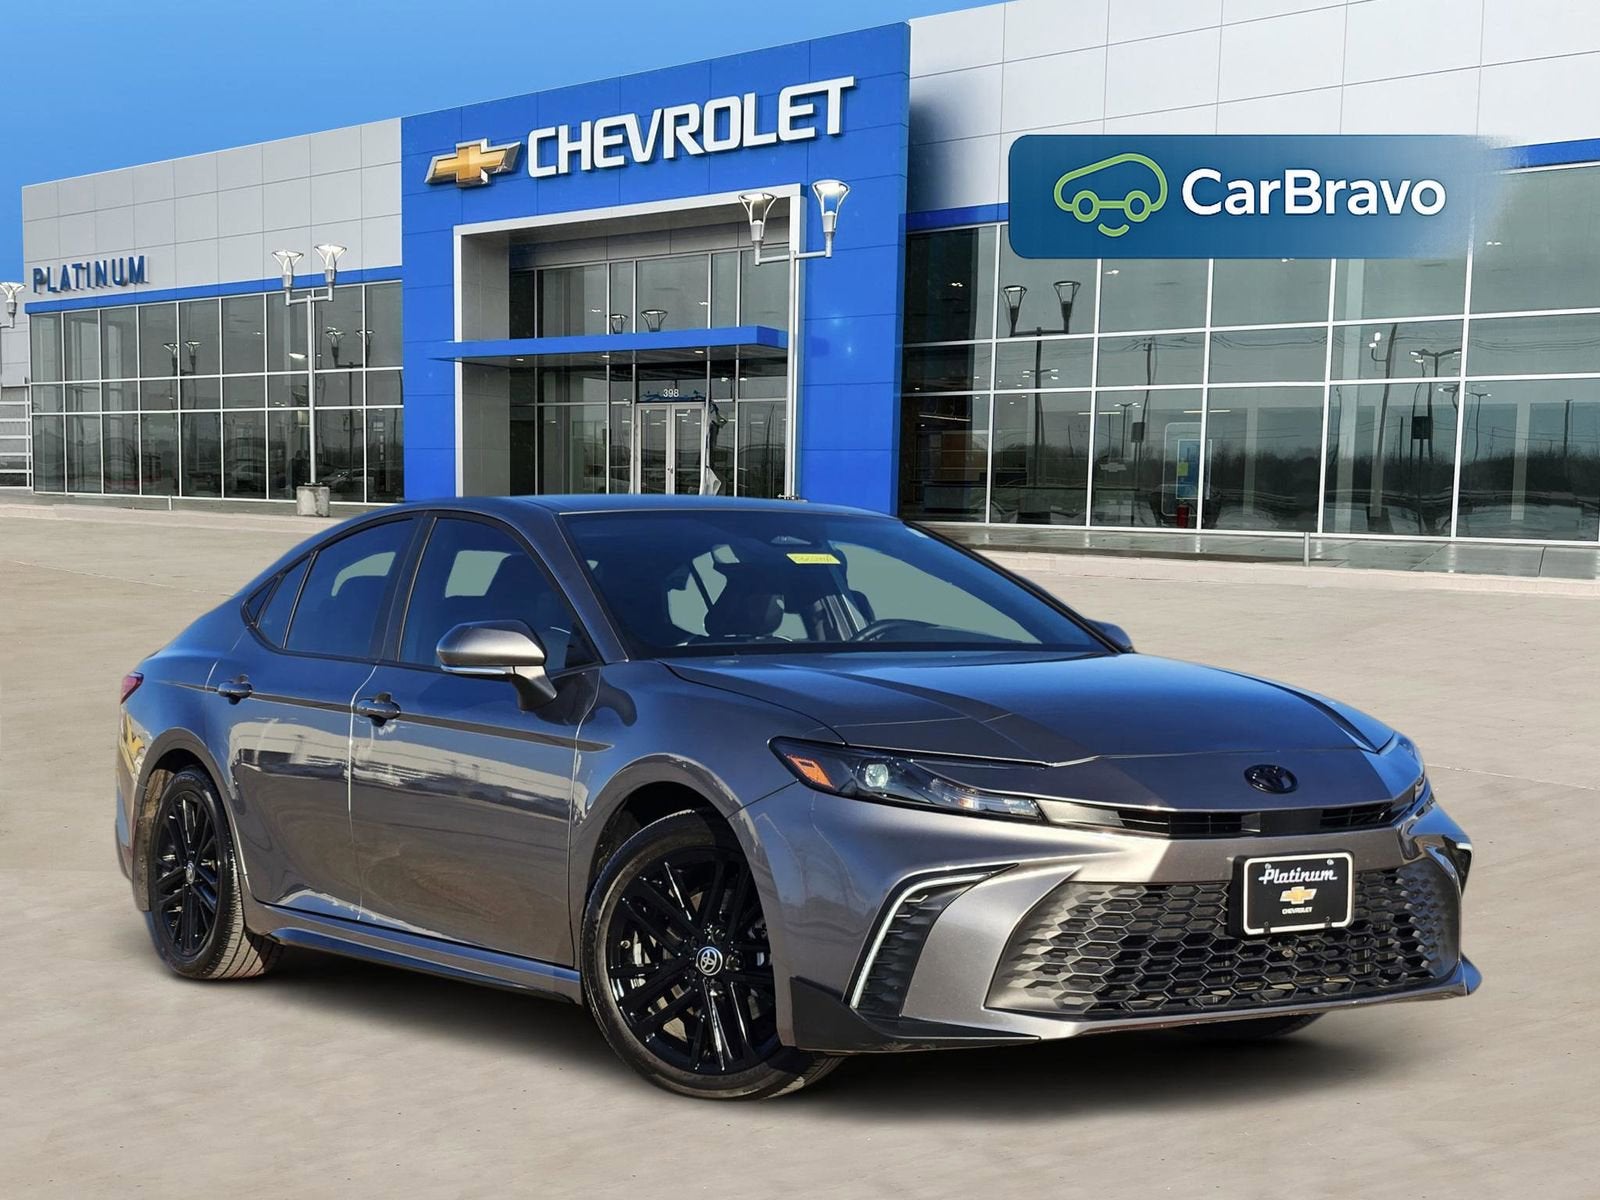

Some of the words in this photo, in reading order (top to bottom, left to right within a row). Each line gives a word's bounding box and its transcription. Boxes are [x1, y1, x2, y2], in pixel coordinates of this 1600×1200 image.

[528, 76, 855, 178] CHEVROLET
[33, 255, 149, 294] PLATINUM
[663, 388, 680, 398] 398
[1258, 867, 1338, 885] Platinum
